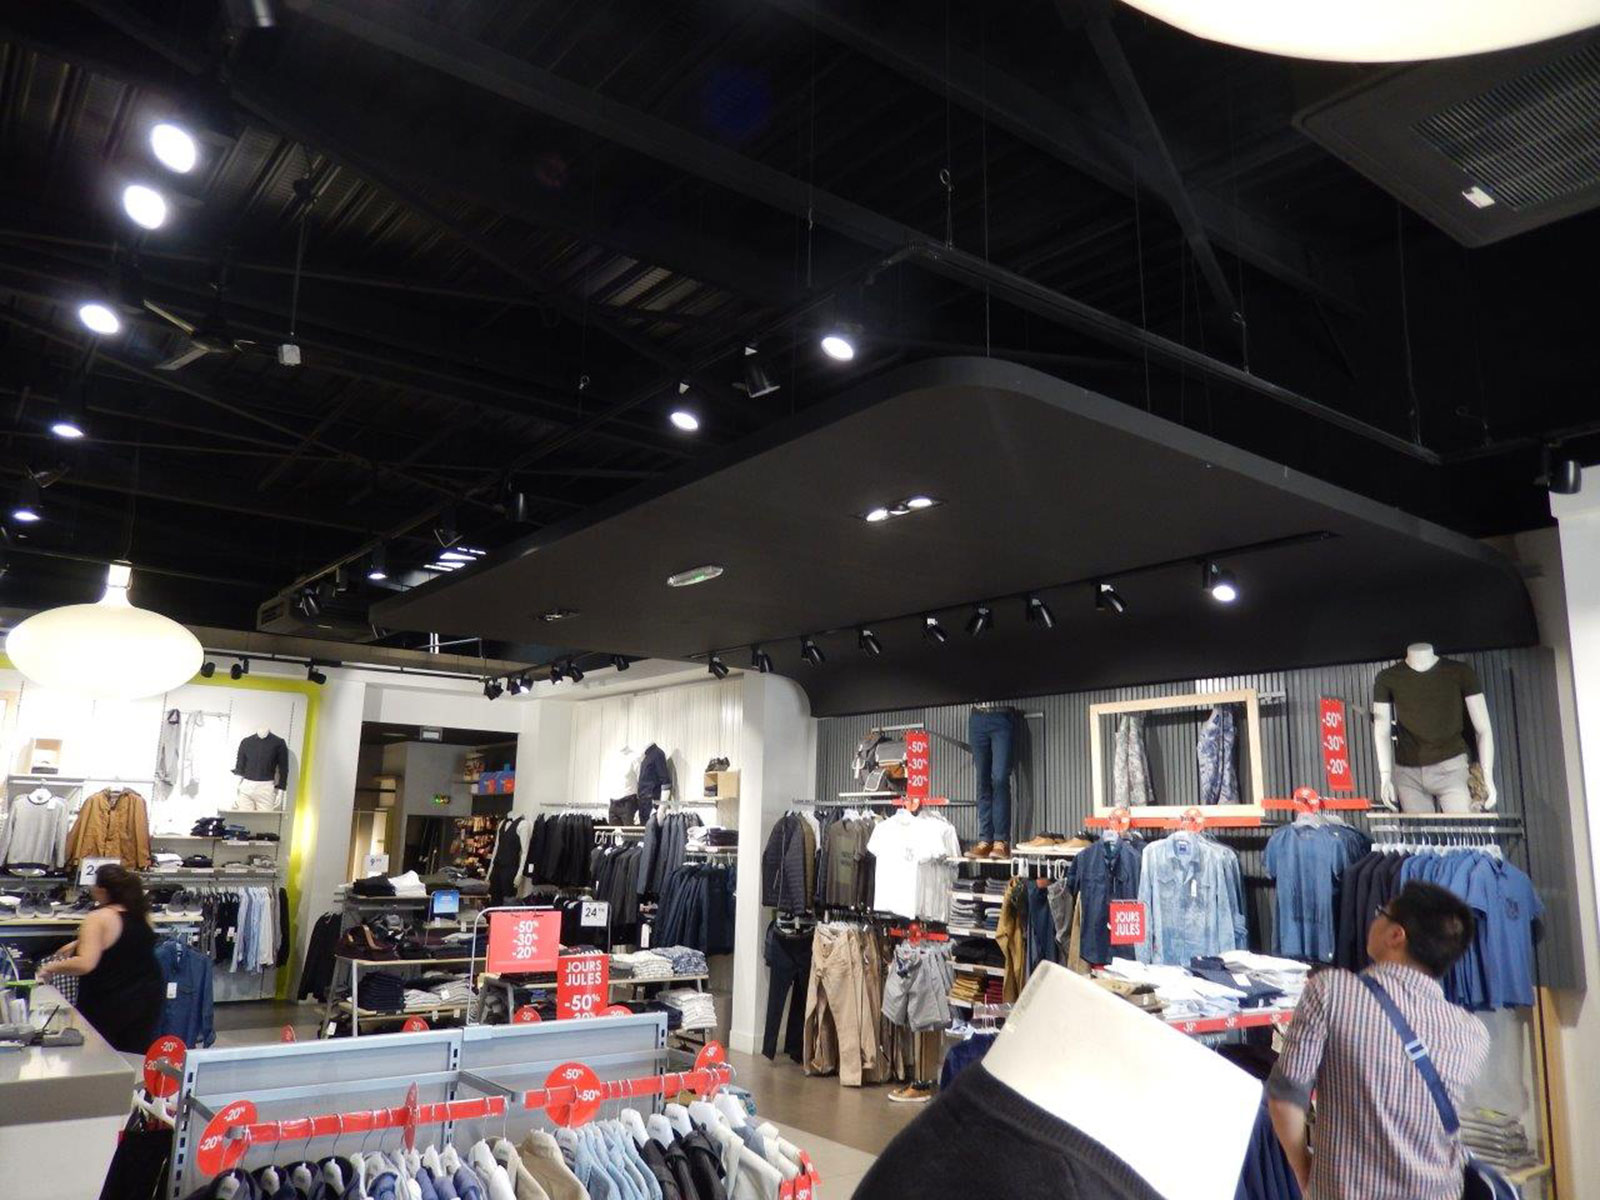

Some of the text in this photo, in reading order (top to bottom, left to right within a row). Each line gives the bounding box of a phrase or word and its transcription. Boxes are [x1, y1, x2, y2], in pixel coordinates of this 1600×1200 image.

[1327, 759, 1348, 774] -20%
[1115, 911, 1140, 923] JOURS
[513, 920, 539, 933] -50%
[1115, 923, 1140, 936] JULES
[513, 933, 538, 946] -30%
[512, 946, 537, 959] -20%
[565, 960, 602, 974] JOURS
[565, 973, 602, 986] JULES
[565, 994, 601, 1011] -50%
[161, 1041, 177, 1052] -20%
[562, 1067, 584, 1080] -50%
[577, 1088, 600, 1101] -50%
[224, 1106, 246, 1122] -20%
[200, 1135, 223, 1150] -20%
